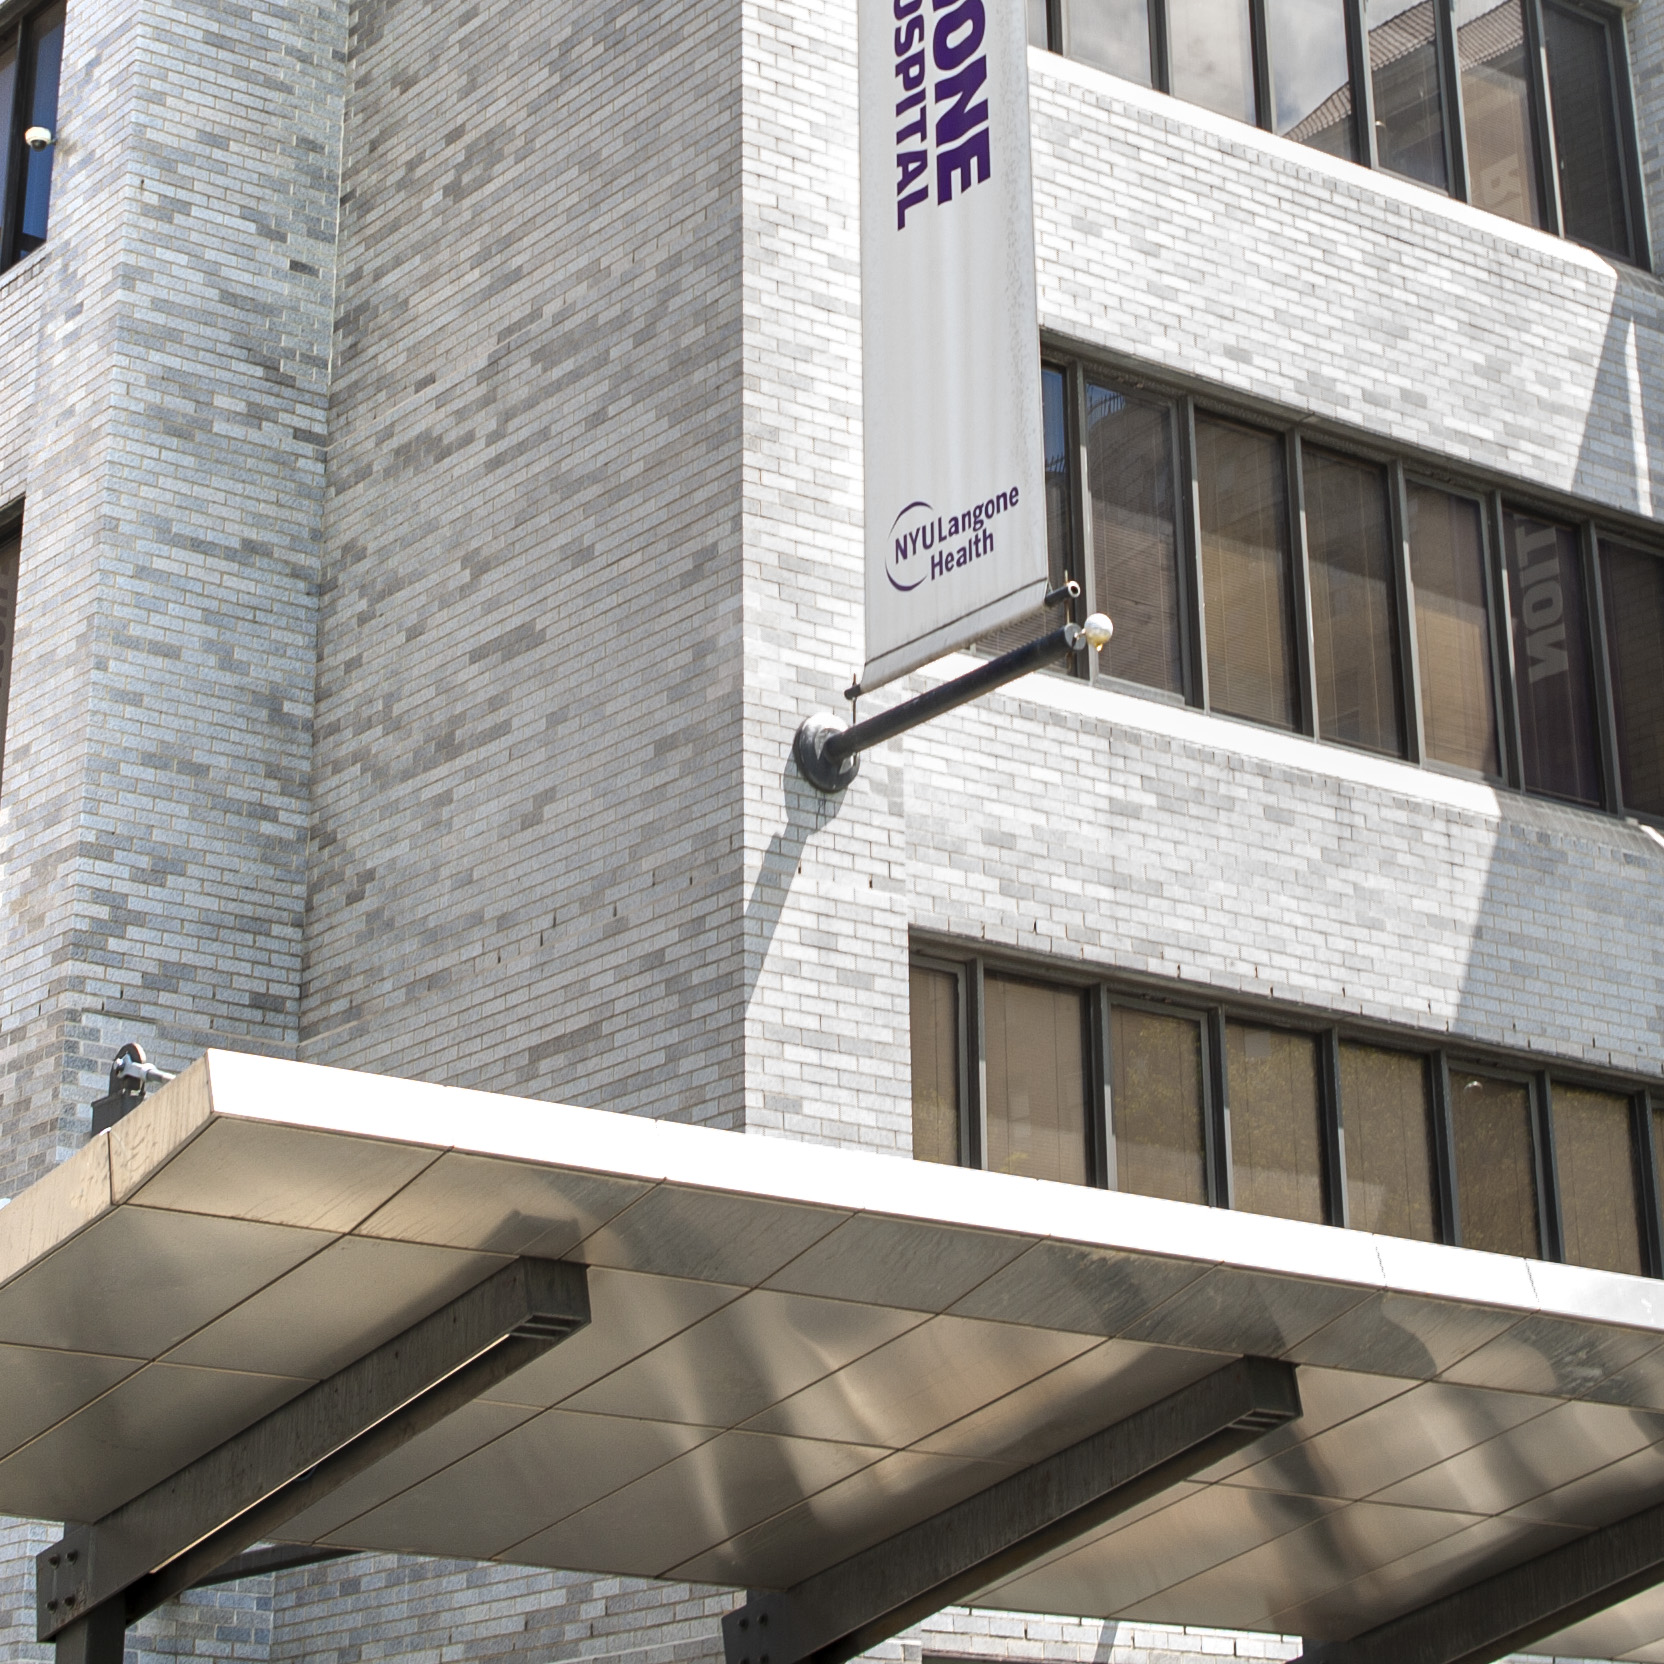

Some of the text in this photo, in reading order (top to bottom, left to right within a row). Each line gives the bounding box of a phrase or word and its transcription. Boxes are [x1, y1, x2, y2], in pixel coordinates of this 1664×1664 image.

[894, 486, 1020, 565] NYU Langone
[930, 527, 995, 582] Health
